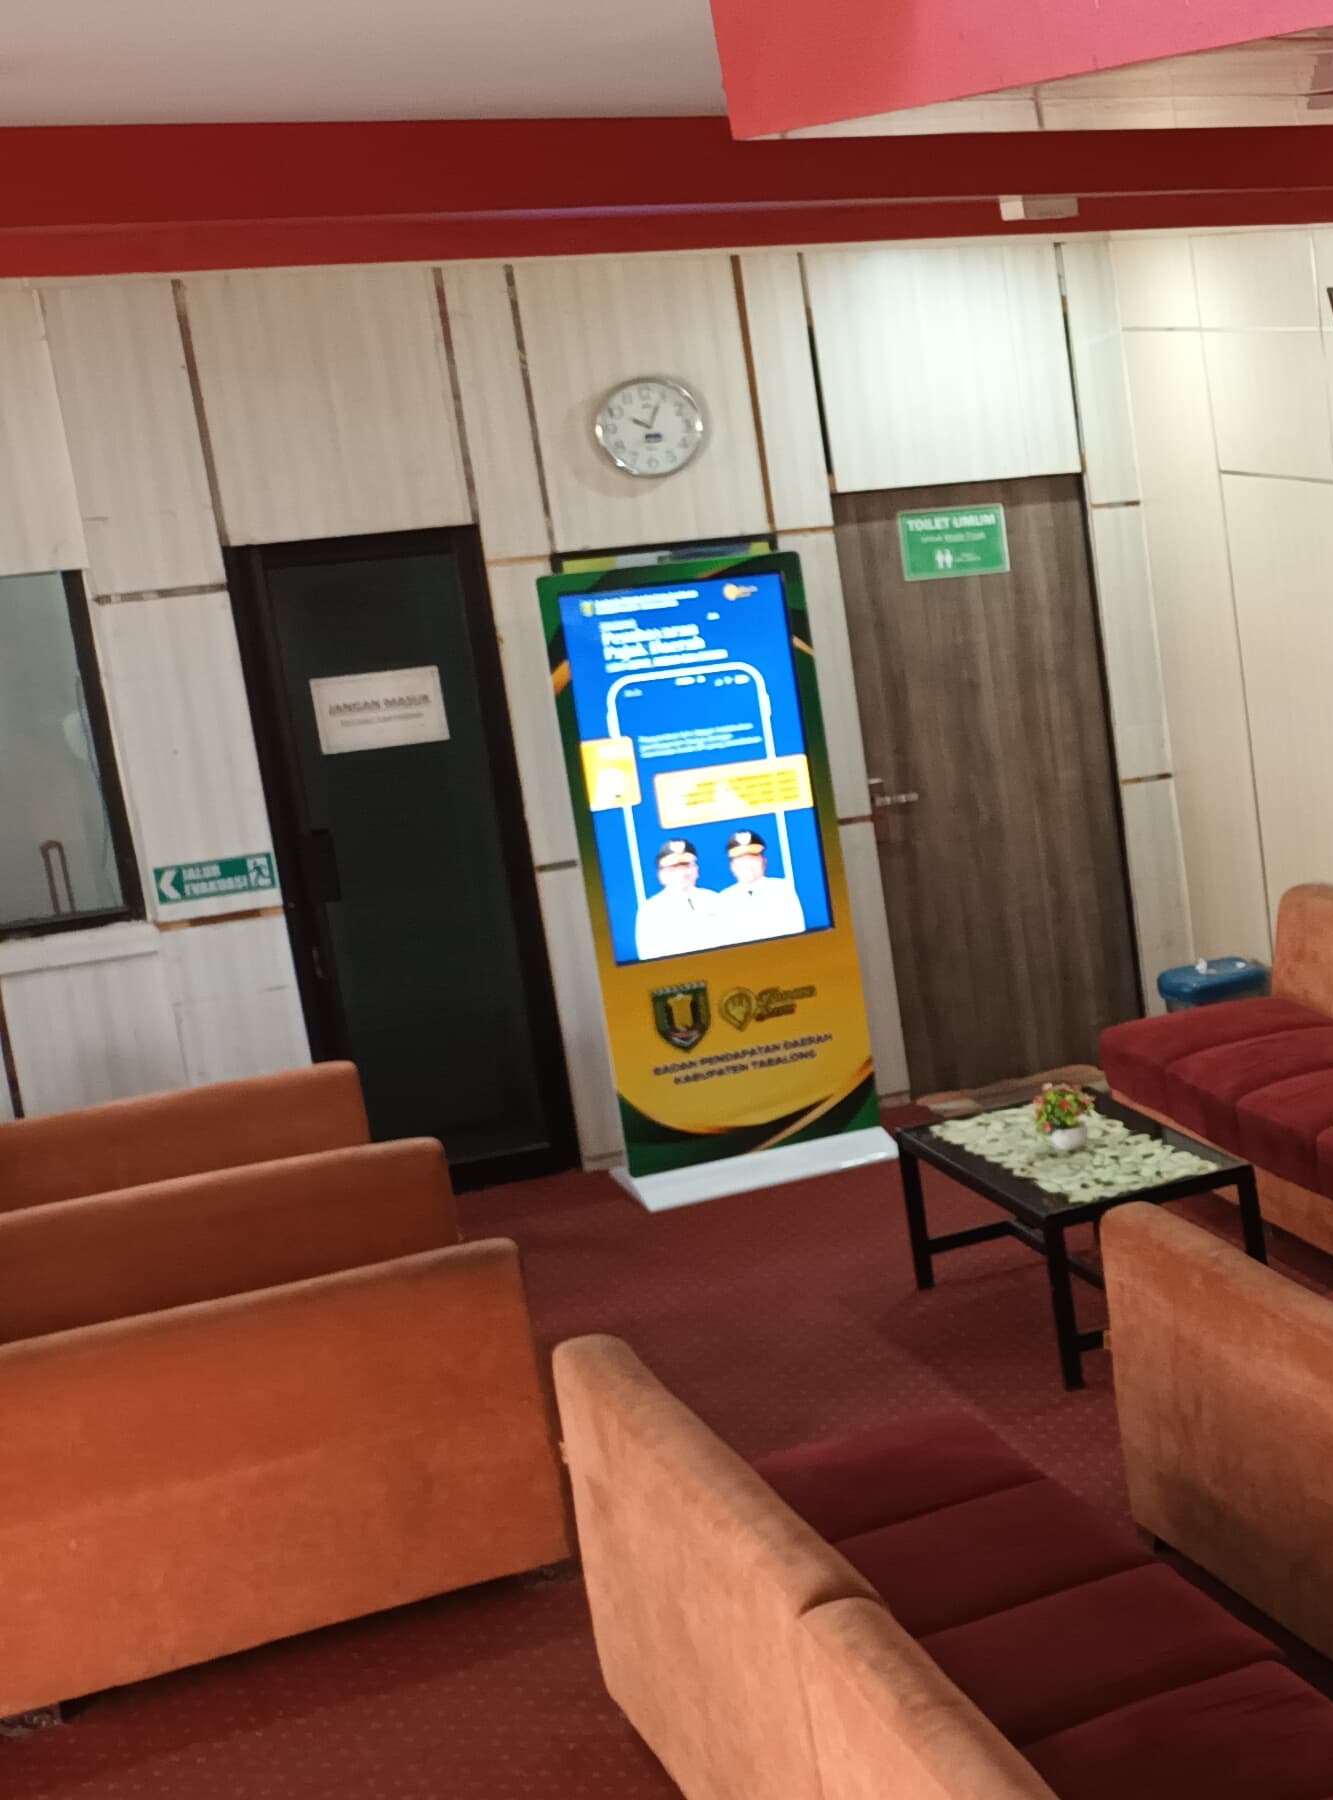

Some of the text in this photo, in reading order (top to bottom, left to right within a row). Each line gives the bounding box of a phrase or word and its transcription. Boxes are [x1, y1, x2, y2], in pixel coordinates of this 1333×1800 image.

[906, 513, 996, 532] TOILET UMUM
[328, 694, 431, 717] JANGAN MASUK
[182, 865, 221, 881] JALUR
[184, 875, 249, 896] EVAKUASI
[653, 1033, 833, 1076] BADAN PENDAPATAN DAERAH
[673, 1049, 818, 1085] KABUPATEN TABALONG
